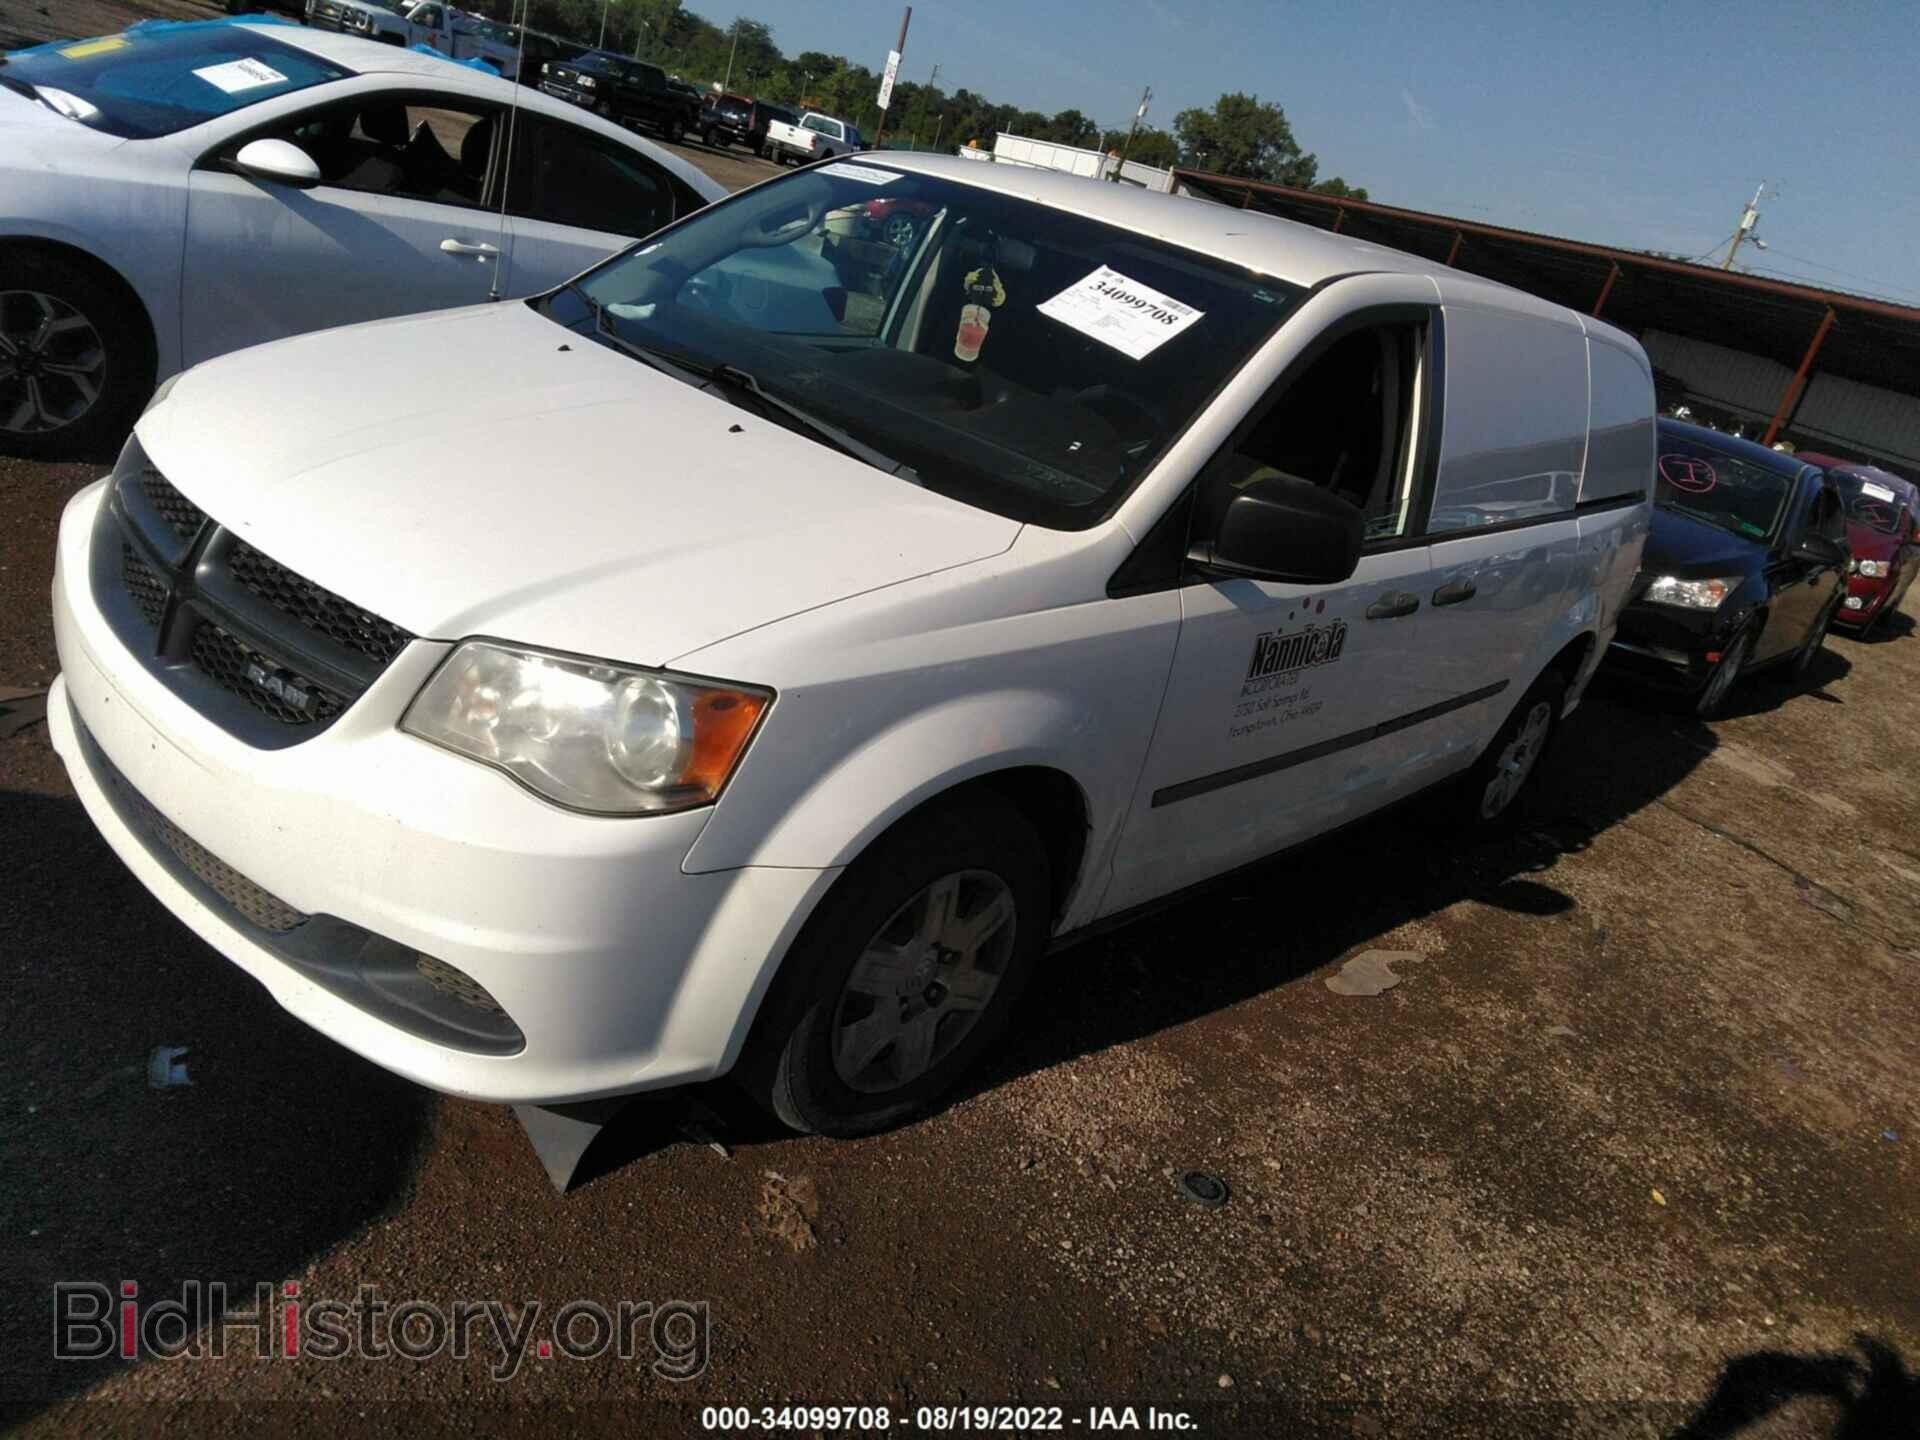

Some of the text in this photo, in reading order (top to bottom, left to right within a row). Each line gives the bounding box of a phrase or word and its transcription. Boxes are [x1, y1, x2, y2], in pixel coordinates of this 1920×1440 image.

[1089, 281, 1179, 325] 34099708
[1247, 618, 1347, 680] Nannicola
[247, 663, 308, 709] RAM
